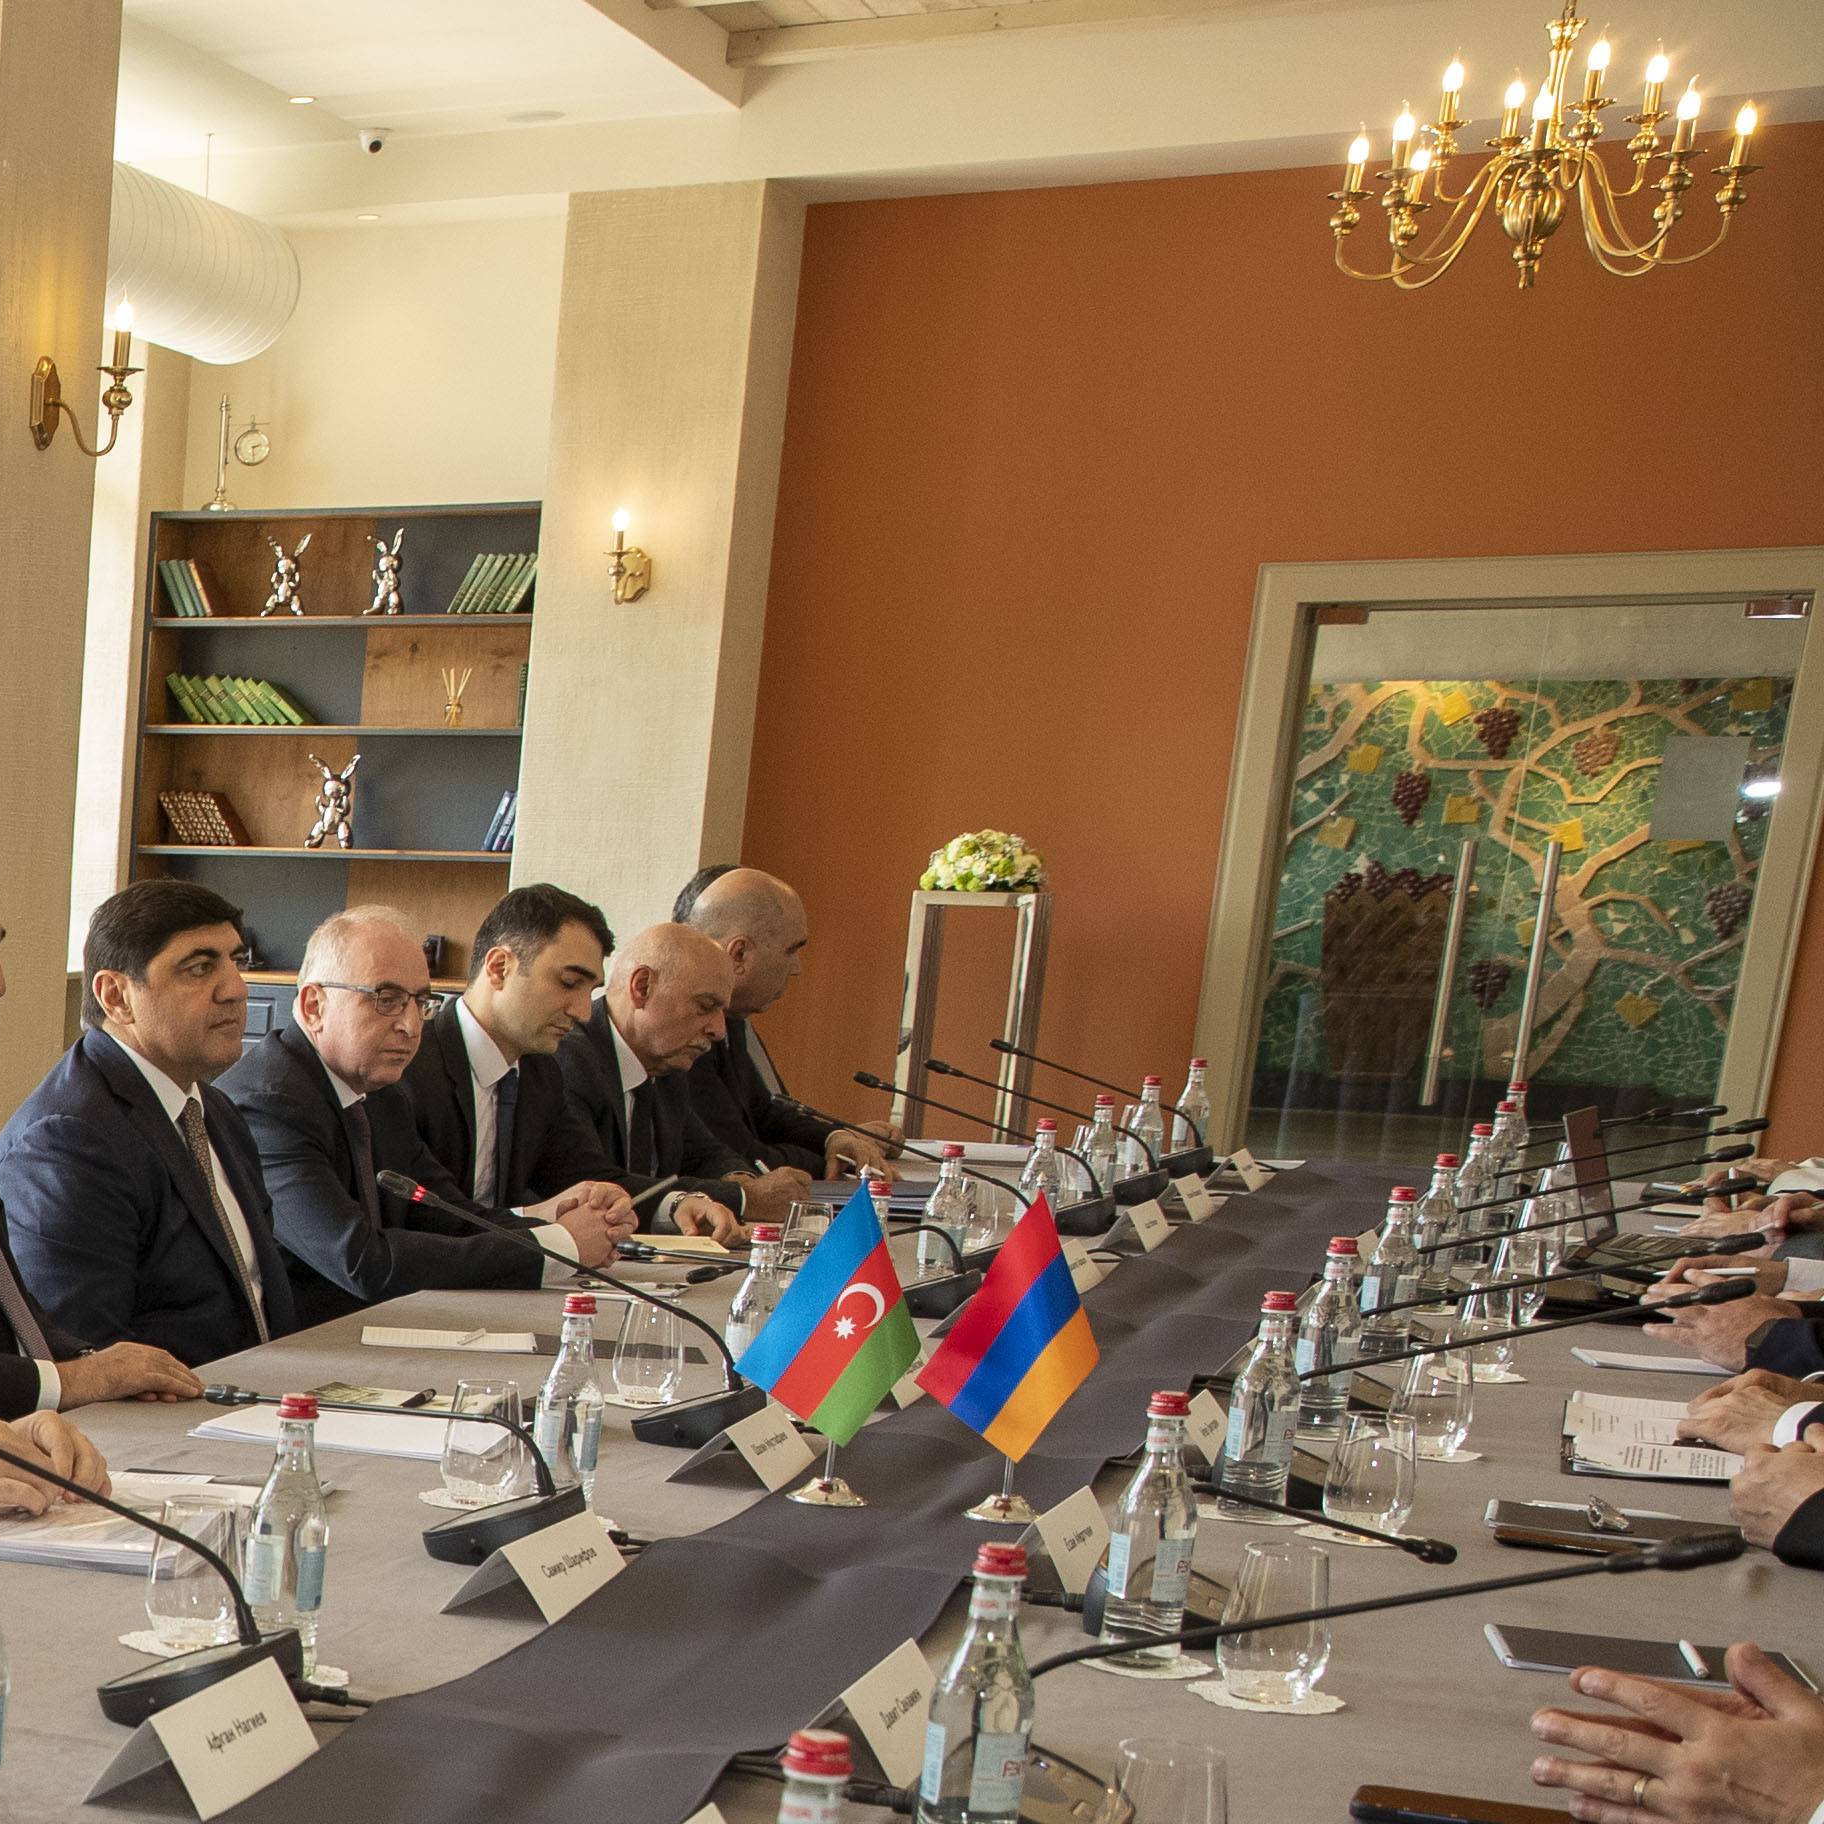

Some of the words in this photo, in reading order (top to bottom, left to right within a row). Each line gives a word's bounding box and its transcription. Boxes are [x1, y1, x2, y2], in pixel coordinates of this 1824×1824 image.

[540, 1562, 568, 1578] Самир
[561, 1547, 597, 1568] Шарифов
[205, 1729, 237, 1755] Афган
[232, 1712, 268, 1738] Нагиев
